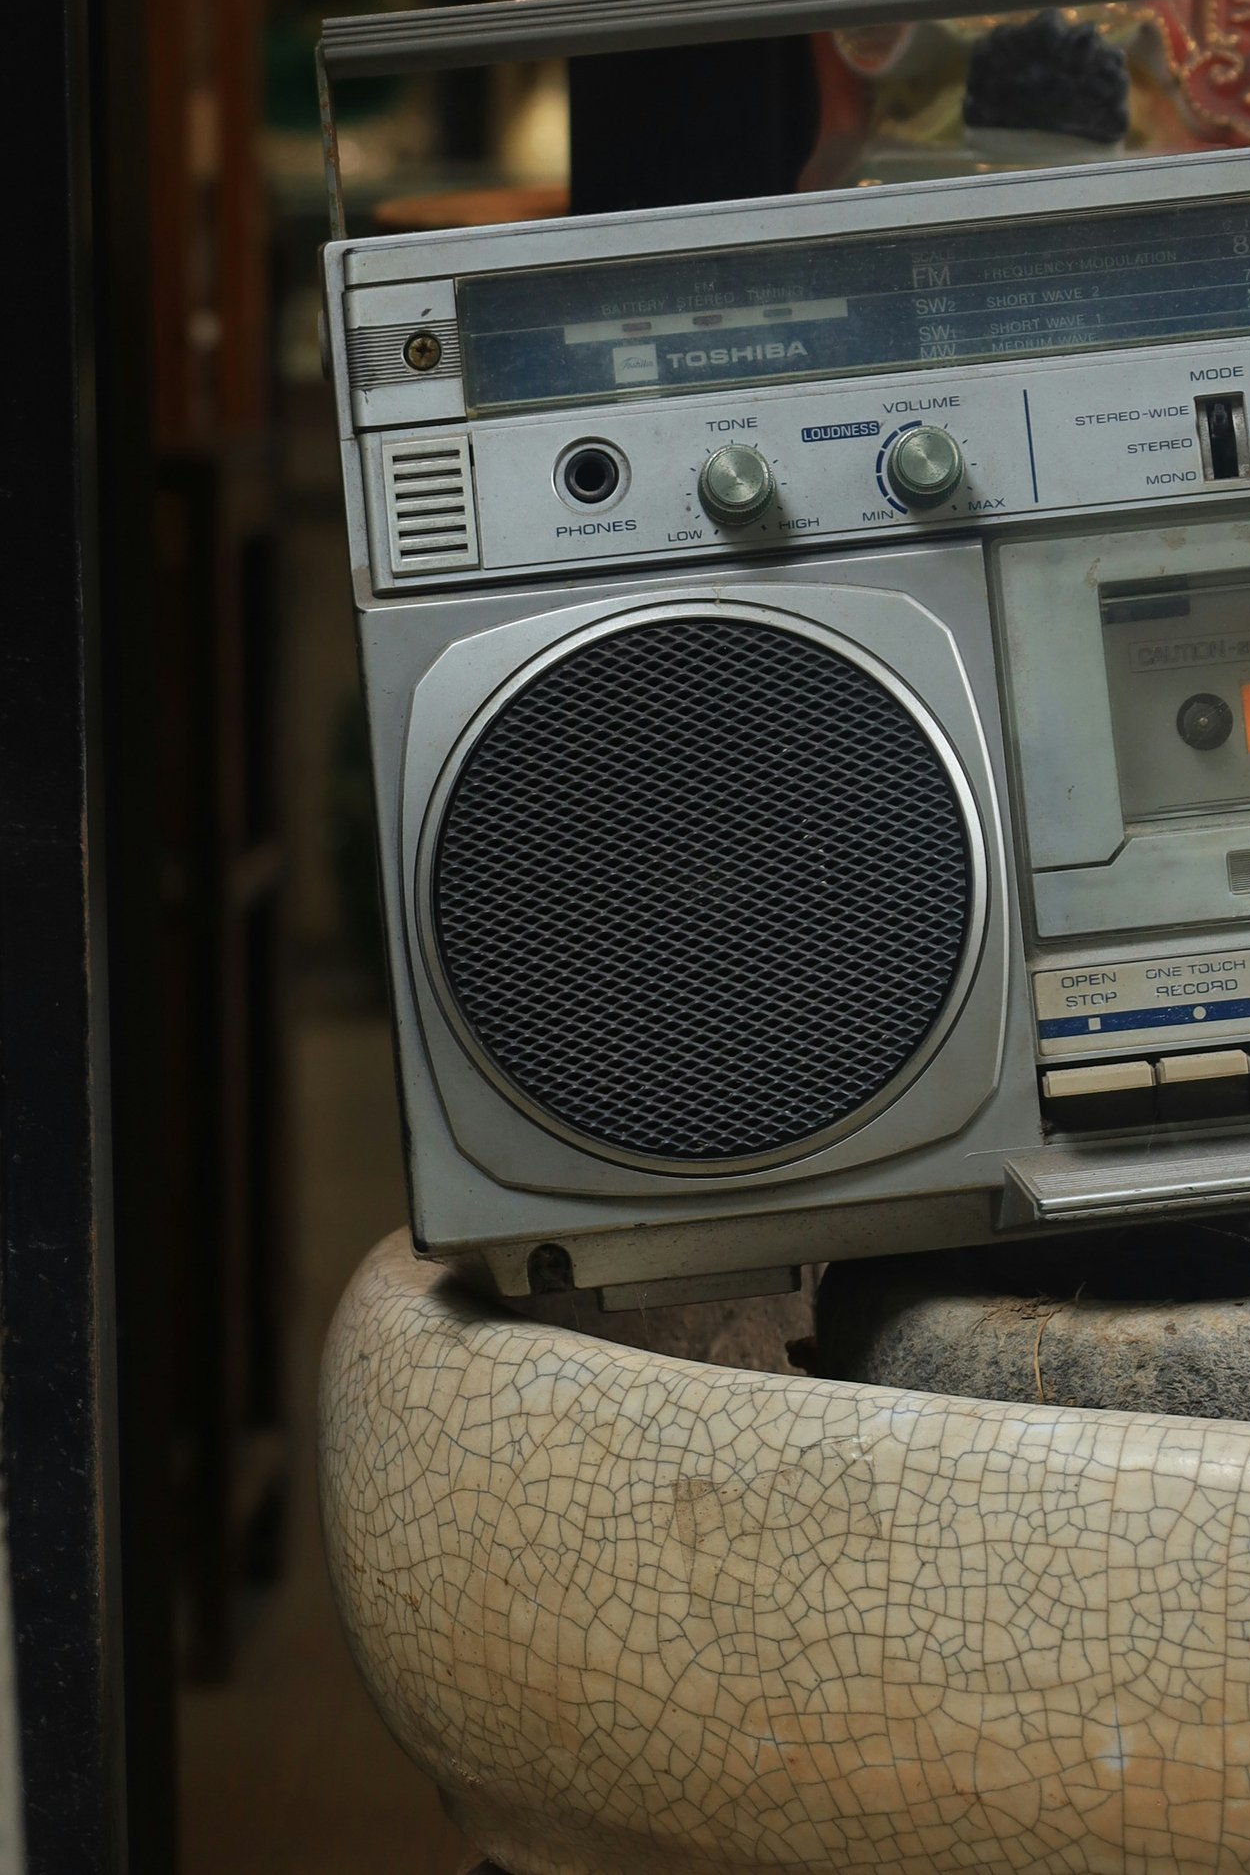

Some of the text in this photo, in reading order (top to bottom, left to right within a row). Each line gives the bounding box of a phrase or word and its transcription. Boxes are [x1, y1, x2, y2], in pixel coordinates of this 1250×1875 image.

[913, 265, 951, 288] FM
[603, 297, 666, 315] BATTERY
[676, 292, 735, 309] STEREO
[916, 286, 1100, 315] SW2 SHORT WAVE 2
[919, 324, 957, 342] SW1
[990, 318, 1040, 335] SHORT
[1046, 314, 1085, 329] WAVE
[666, 341, 808, 369] TOSHIBA
[920, 332, 1098, 360] MW MEDIUM WAVE
[1189, 366, 1244, 382] MODE
[882, 395, 961, 413] VOLUME
[706, 416, 758, 432] TONE
[1075, 405, 1189, 426] STEREO-WIDE
[803, 422, 879, 441] LOUDNESS
[1127, 438, 1193, 454] STEREO
[1145, 470, 1197, 486] MONO
[862, 497, 1006, 522] MIN MAX
[555, 519, 638, 538] PHONES
[668, 517, 820, 542] LOW HIGH
[1145, 959, 1246, 980] ONE TOUCH
[1061, 971, 1117, 989] OPEN
[1156, 978, 1239, 998] RECORD
[1065, 991, 1118, 1008] STOP
